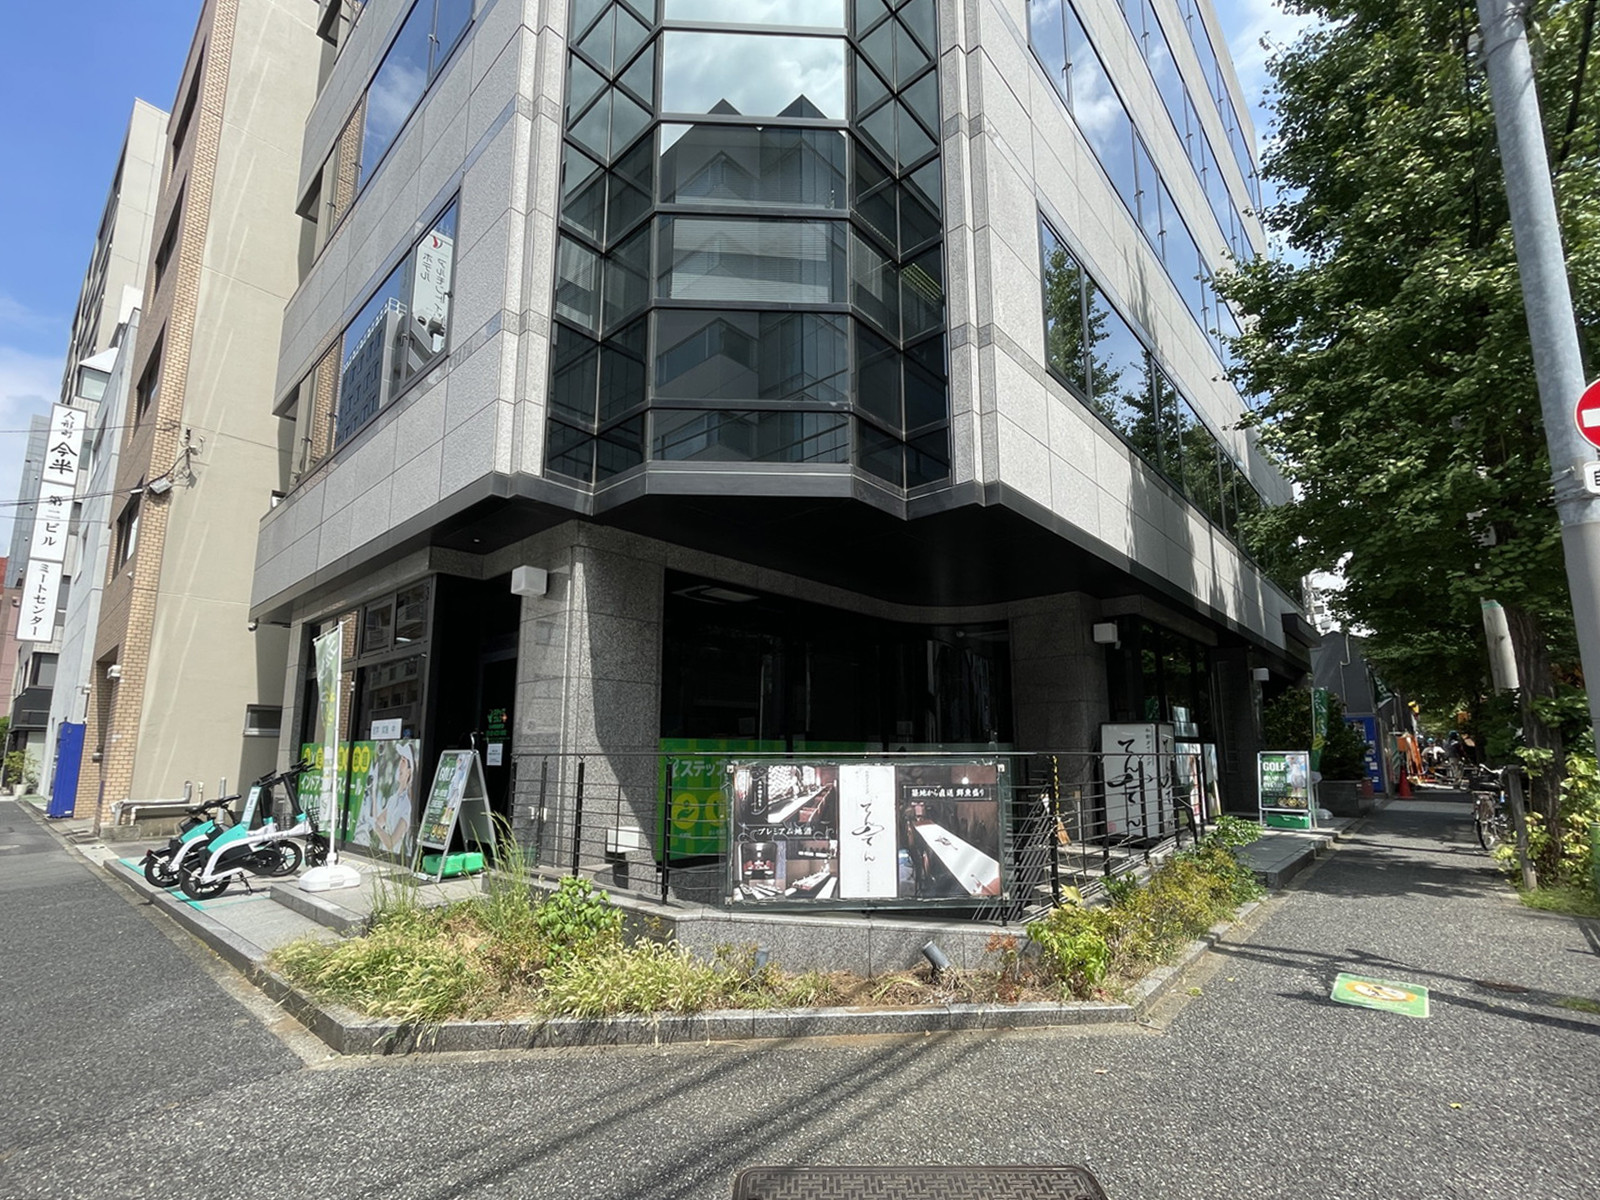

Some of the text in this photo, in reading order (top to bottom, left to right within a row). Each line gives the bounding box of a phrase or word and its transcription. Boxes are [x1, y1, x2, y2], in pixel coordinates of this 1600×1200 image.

[48, 441, 78, 475] 今半
[41, 494, 62, 547] 第二ビル
[30, 563, 50, 636] ミートセンター
[1262, 761, 1286, 772] GOLF
